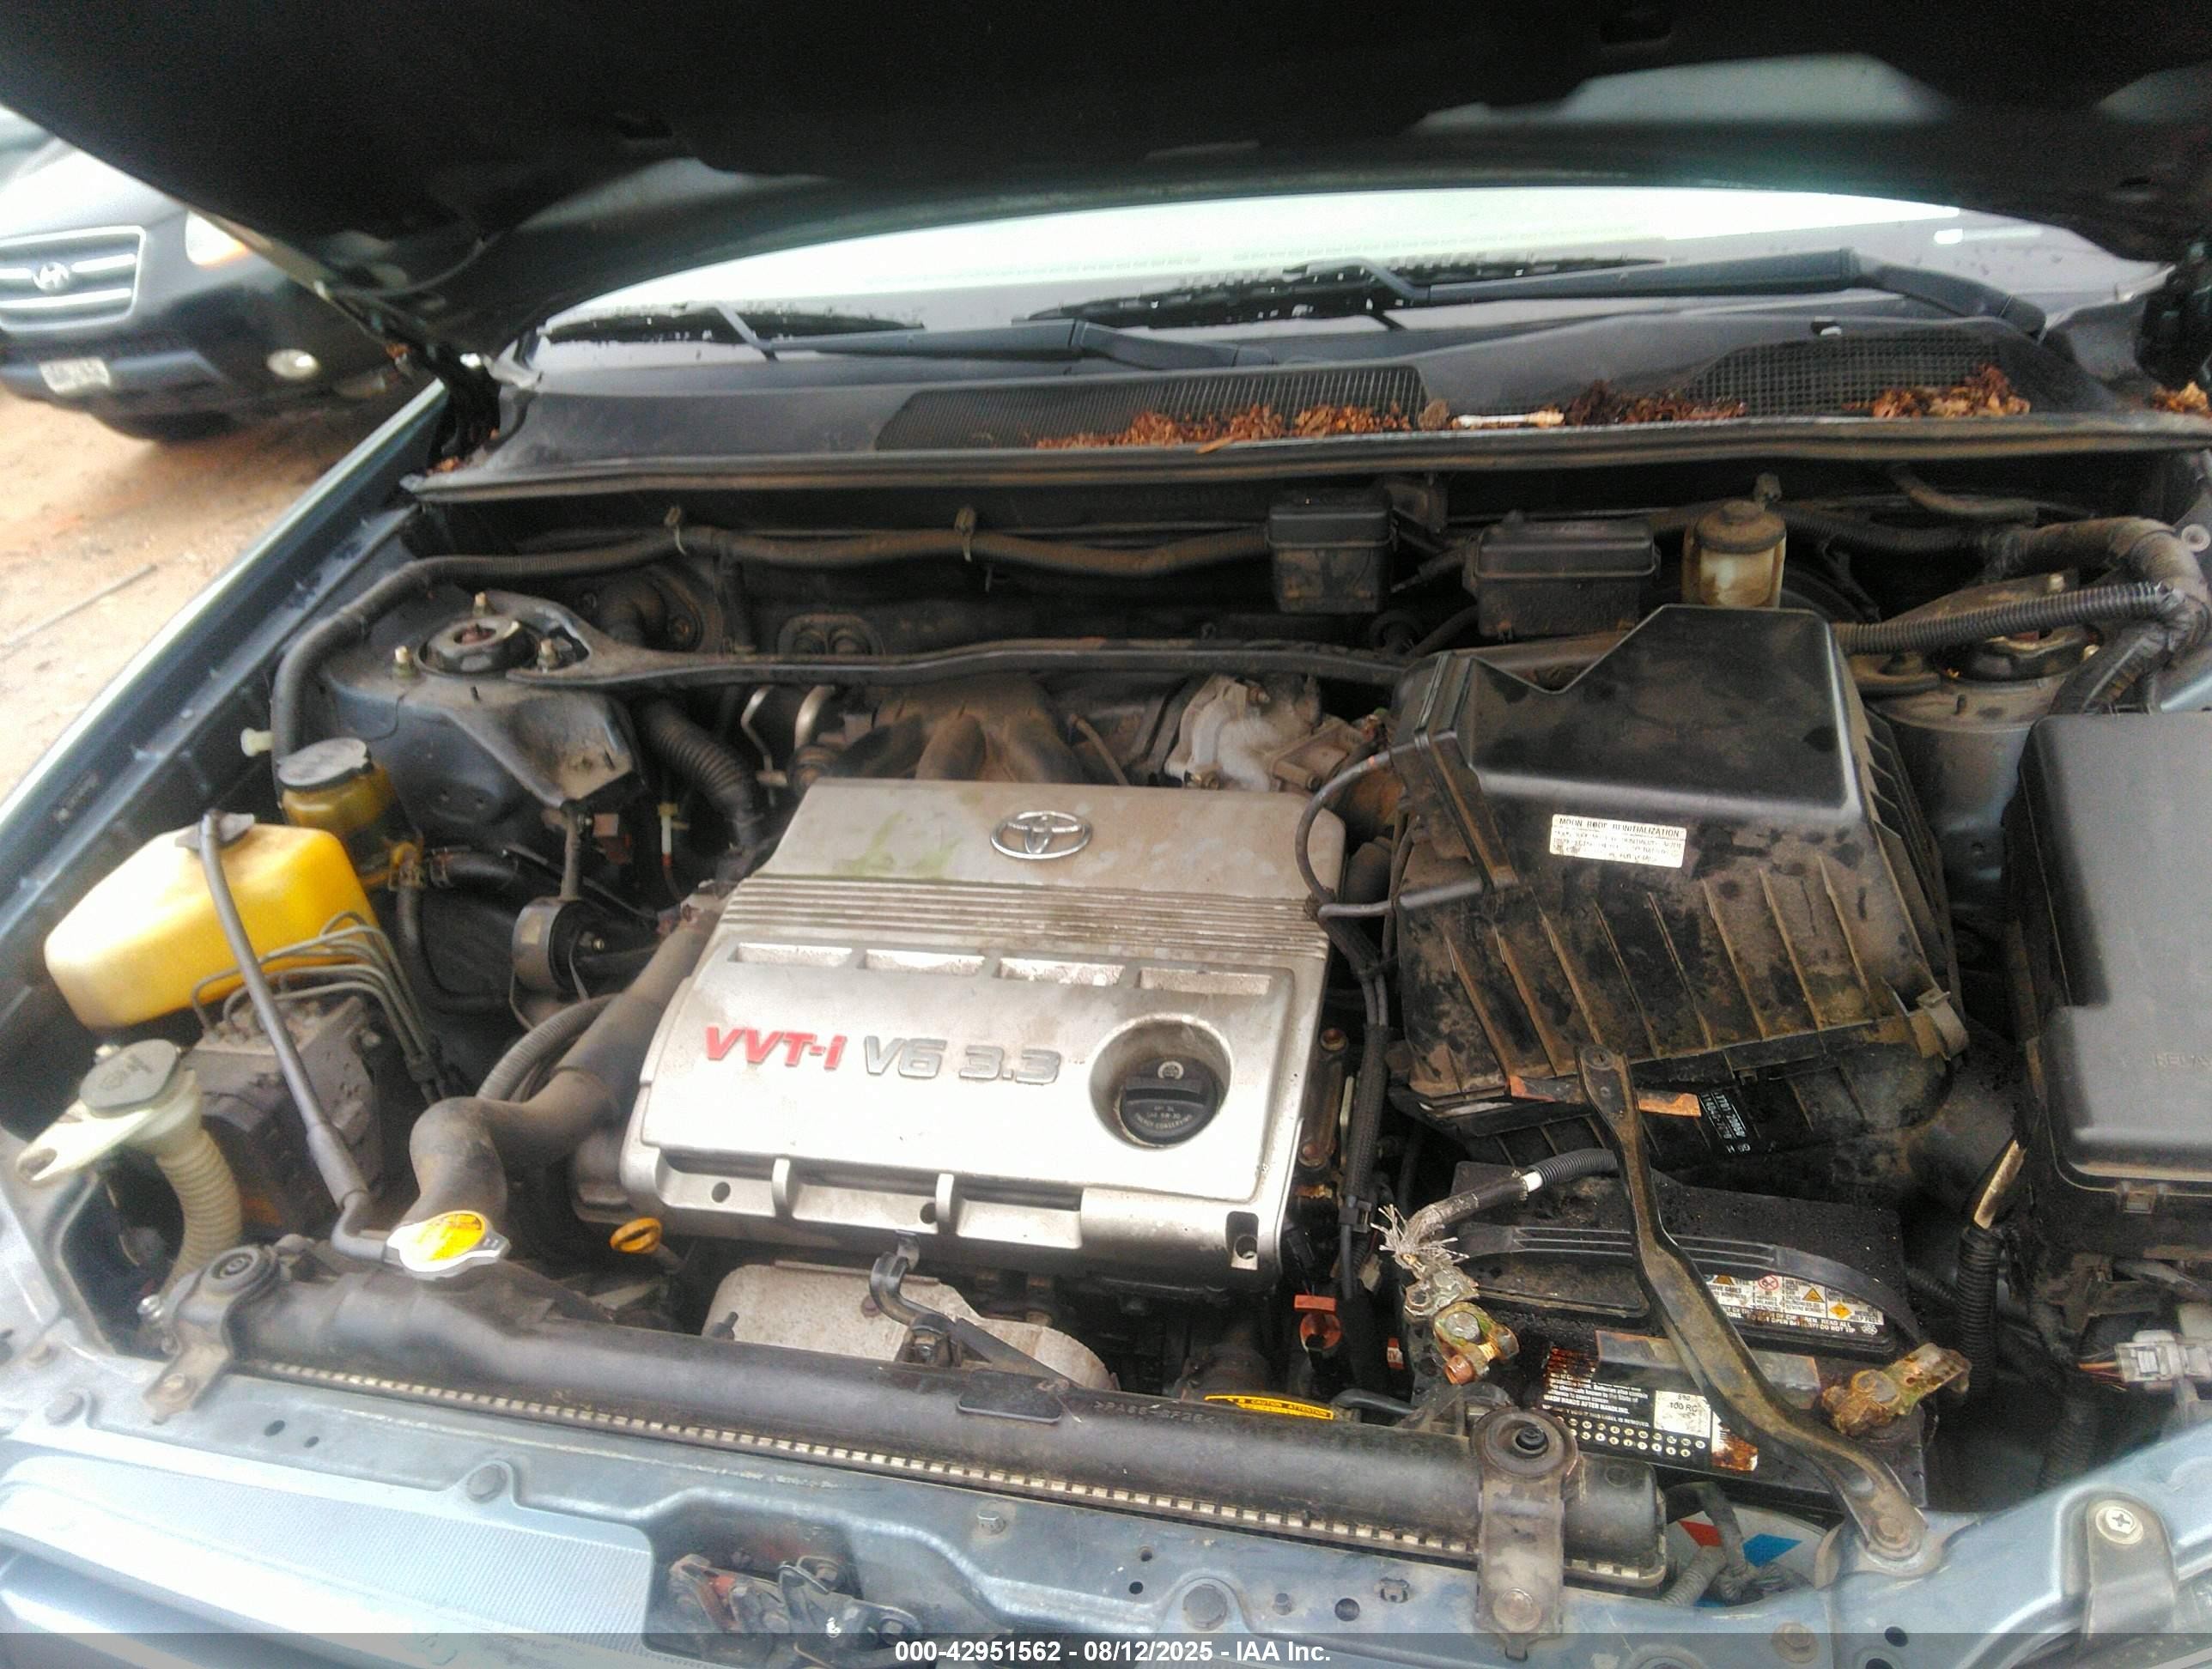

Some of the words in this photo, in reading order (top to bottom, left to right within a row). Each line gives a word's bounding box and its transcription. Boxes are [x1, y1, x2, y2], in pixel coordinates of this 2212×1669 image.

[1559, 817, 1582, 826] MOON
[1612, 823, 1679, 837] REINITIALIZATION
[864, 1035, 947, 1077] V6
[959, 1045, 1061, 1085] 3.3
[1580, 1400, 1599, 1409] AFTER
